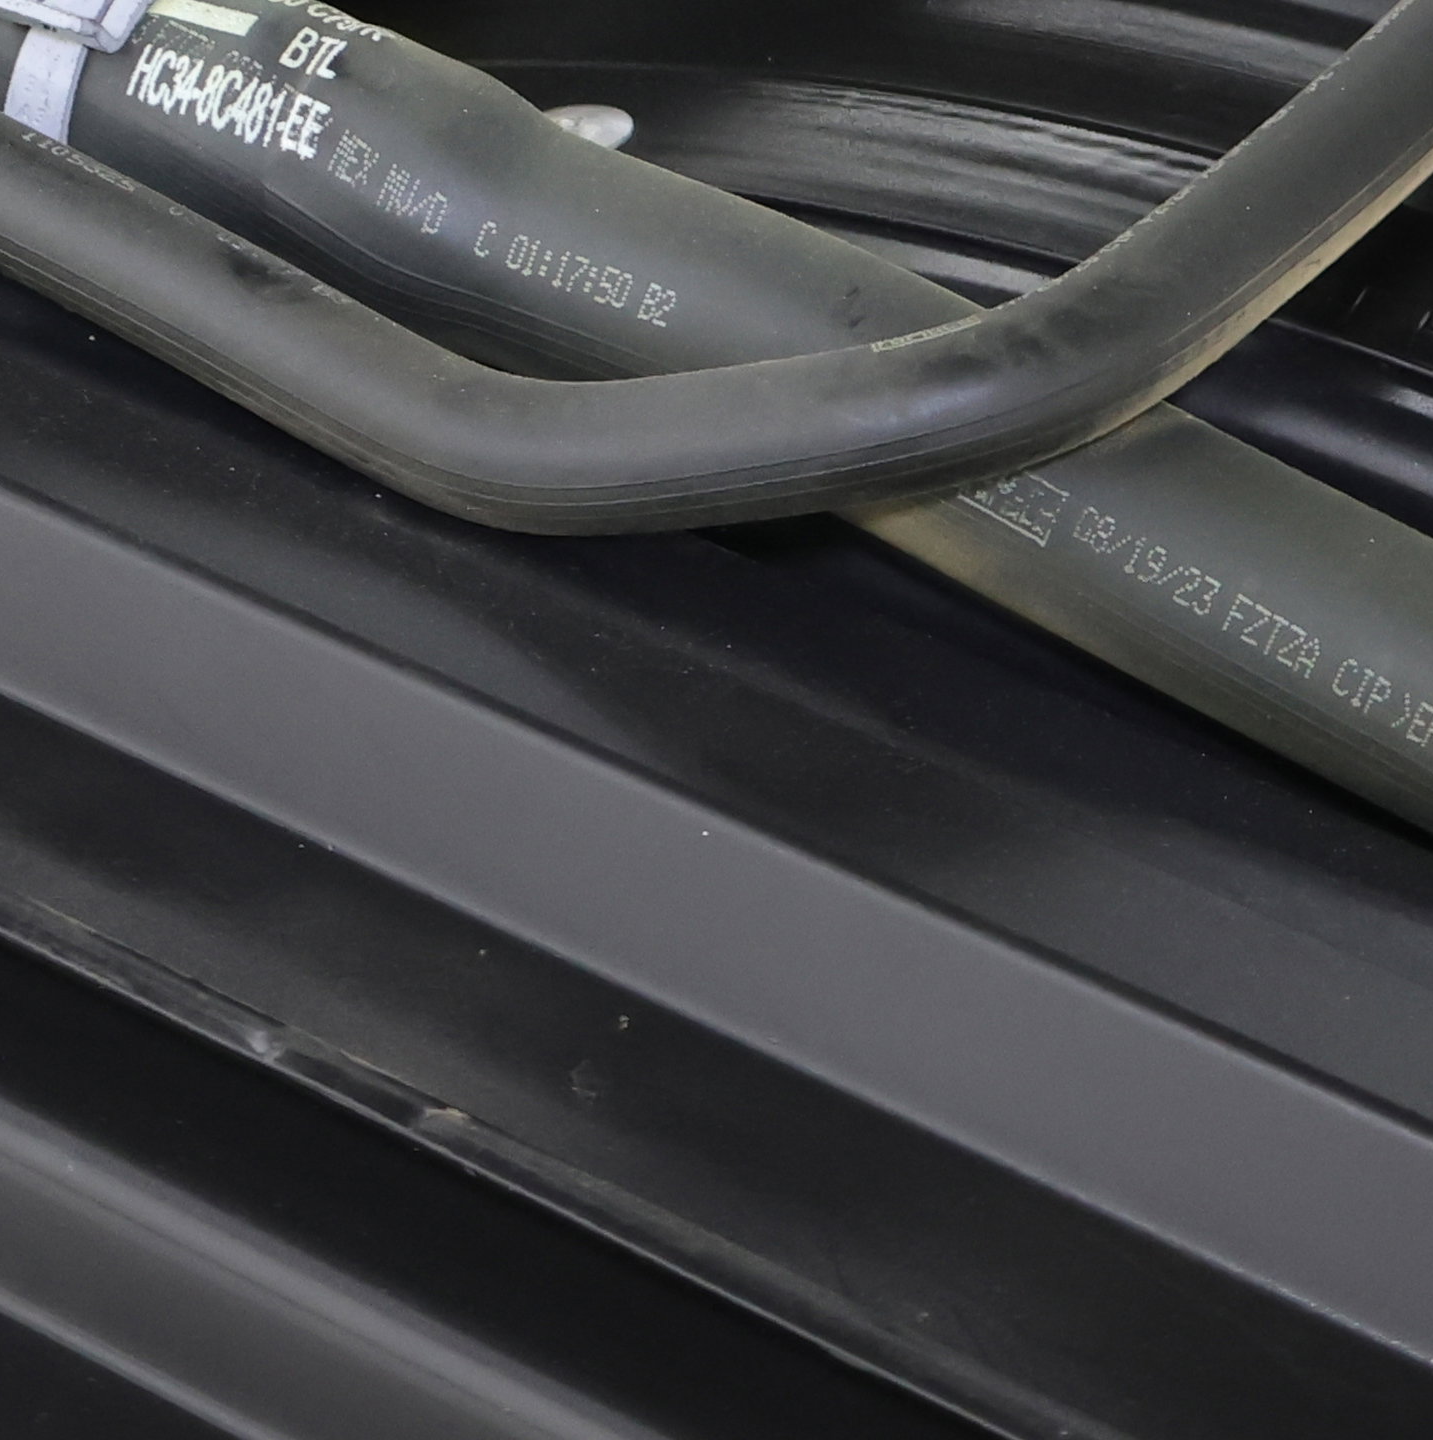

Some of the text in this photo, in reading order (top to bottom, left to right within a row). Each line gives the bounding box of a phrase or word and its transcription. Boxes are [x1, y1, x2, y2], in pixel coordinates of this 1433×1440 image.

[279, 26, 348, 80] BTL
[473, 220, 498, 258] C
[637, 281, 677, 328] B2
[1072, 505, 1222, 616] 08/19/23
[1332, 657, 1392, 714] CIP
